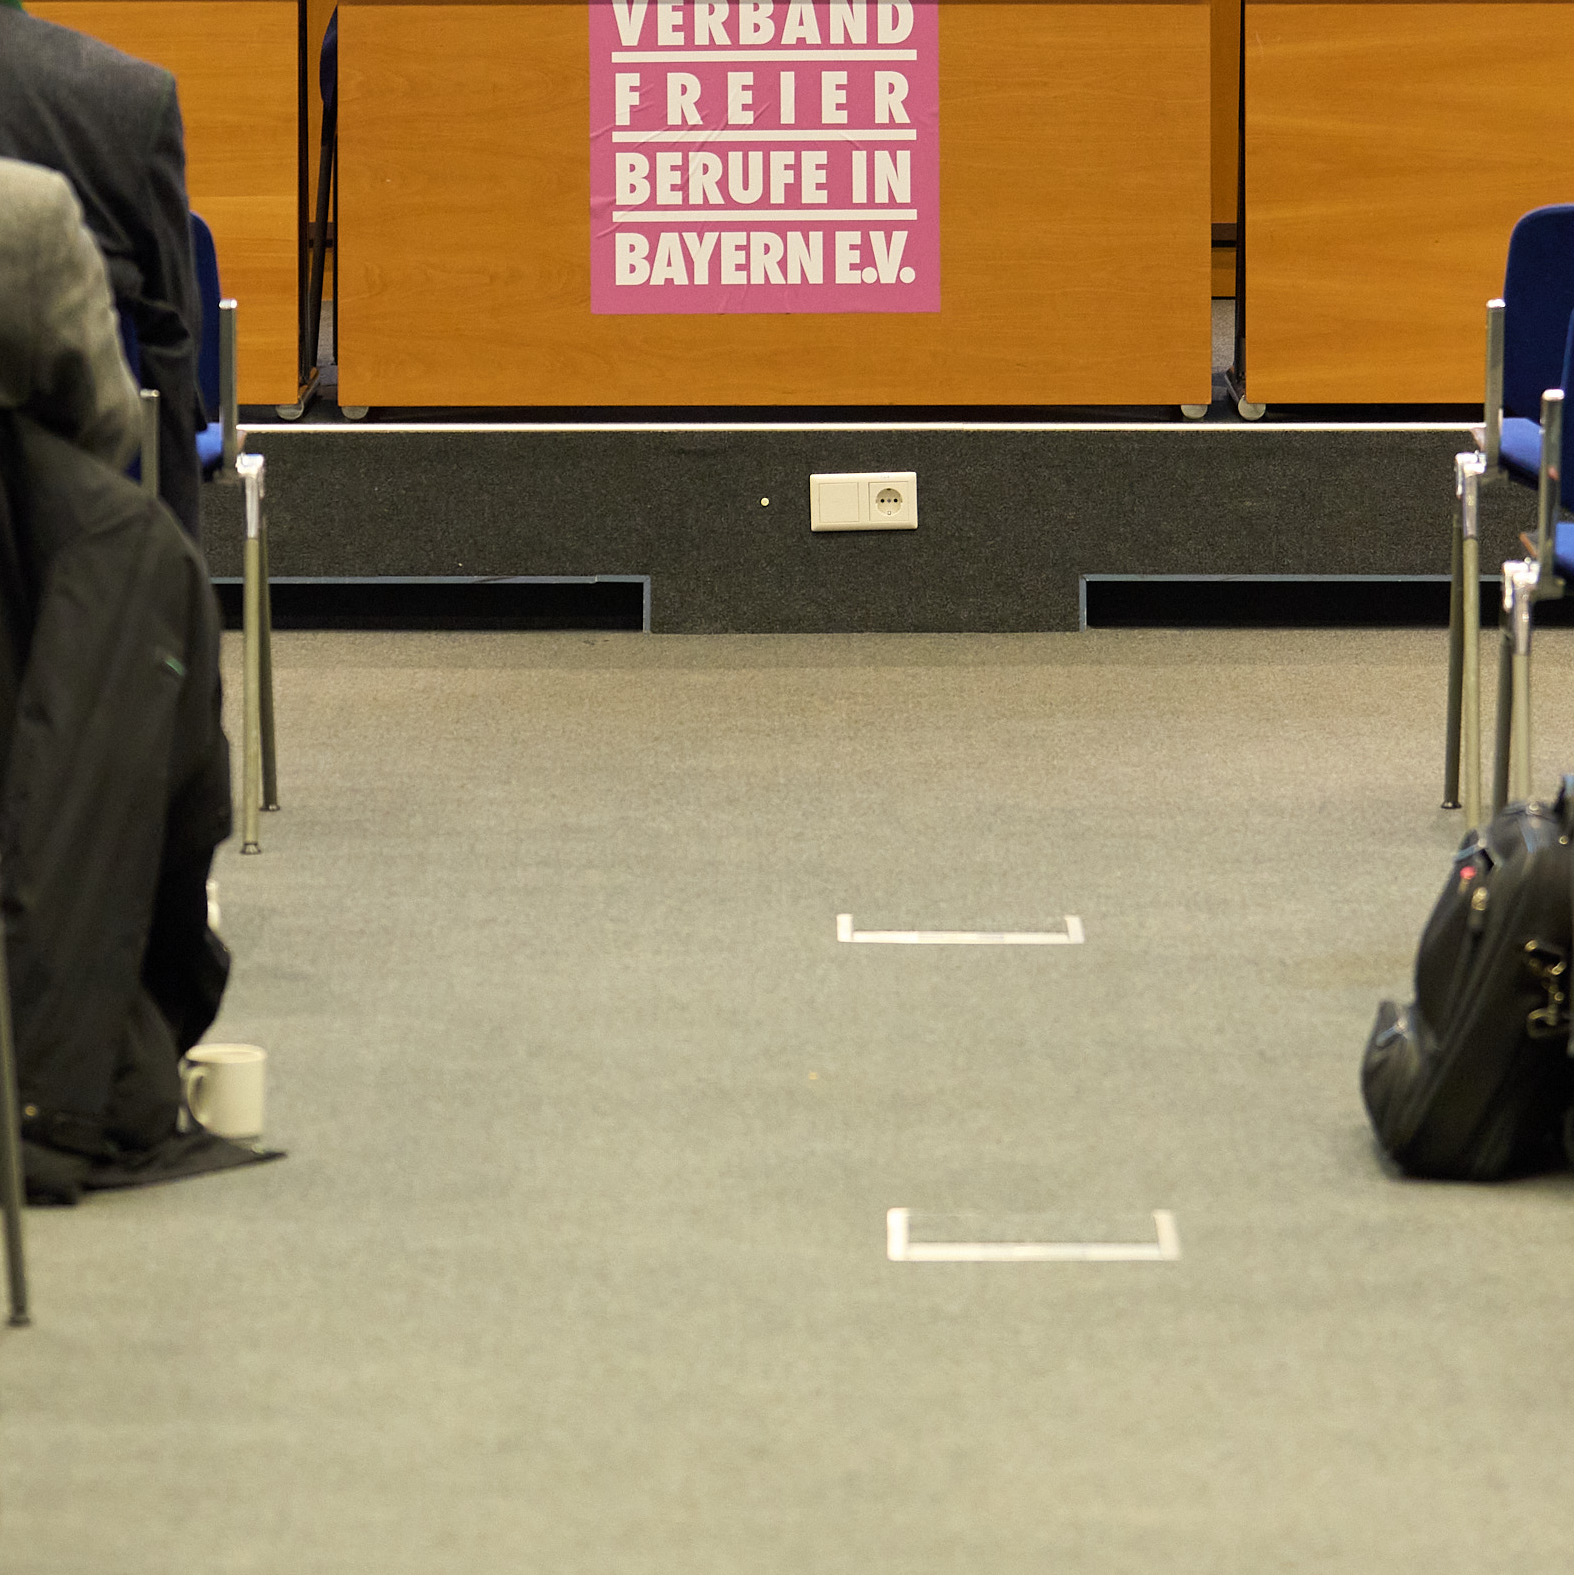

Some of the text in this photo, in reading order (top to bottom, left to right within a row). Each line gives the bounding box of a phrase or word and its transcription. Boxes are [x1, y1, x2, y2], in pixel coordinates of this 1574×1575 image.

[614, 70, 912, 126] FREIER
[615, 150, 912, 206] BERUFE IN
[615, 230, 916, 286] BAYERN E.V.
